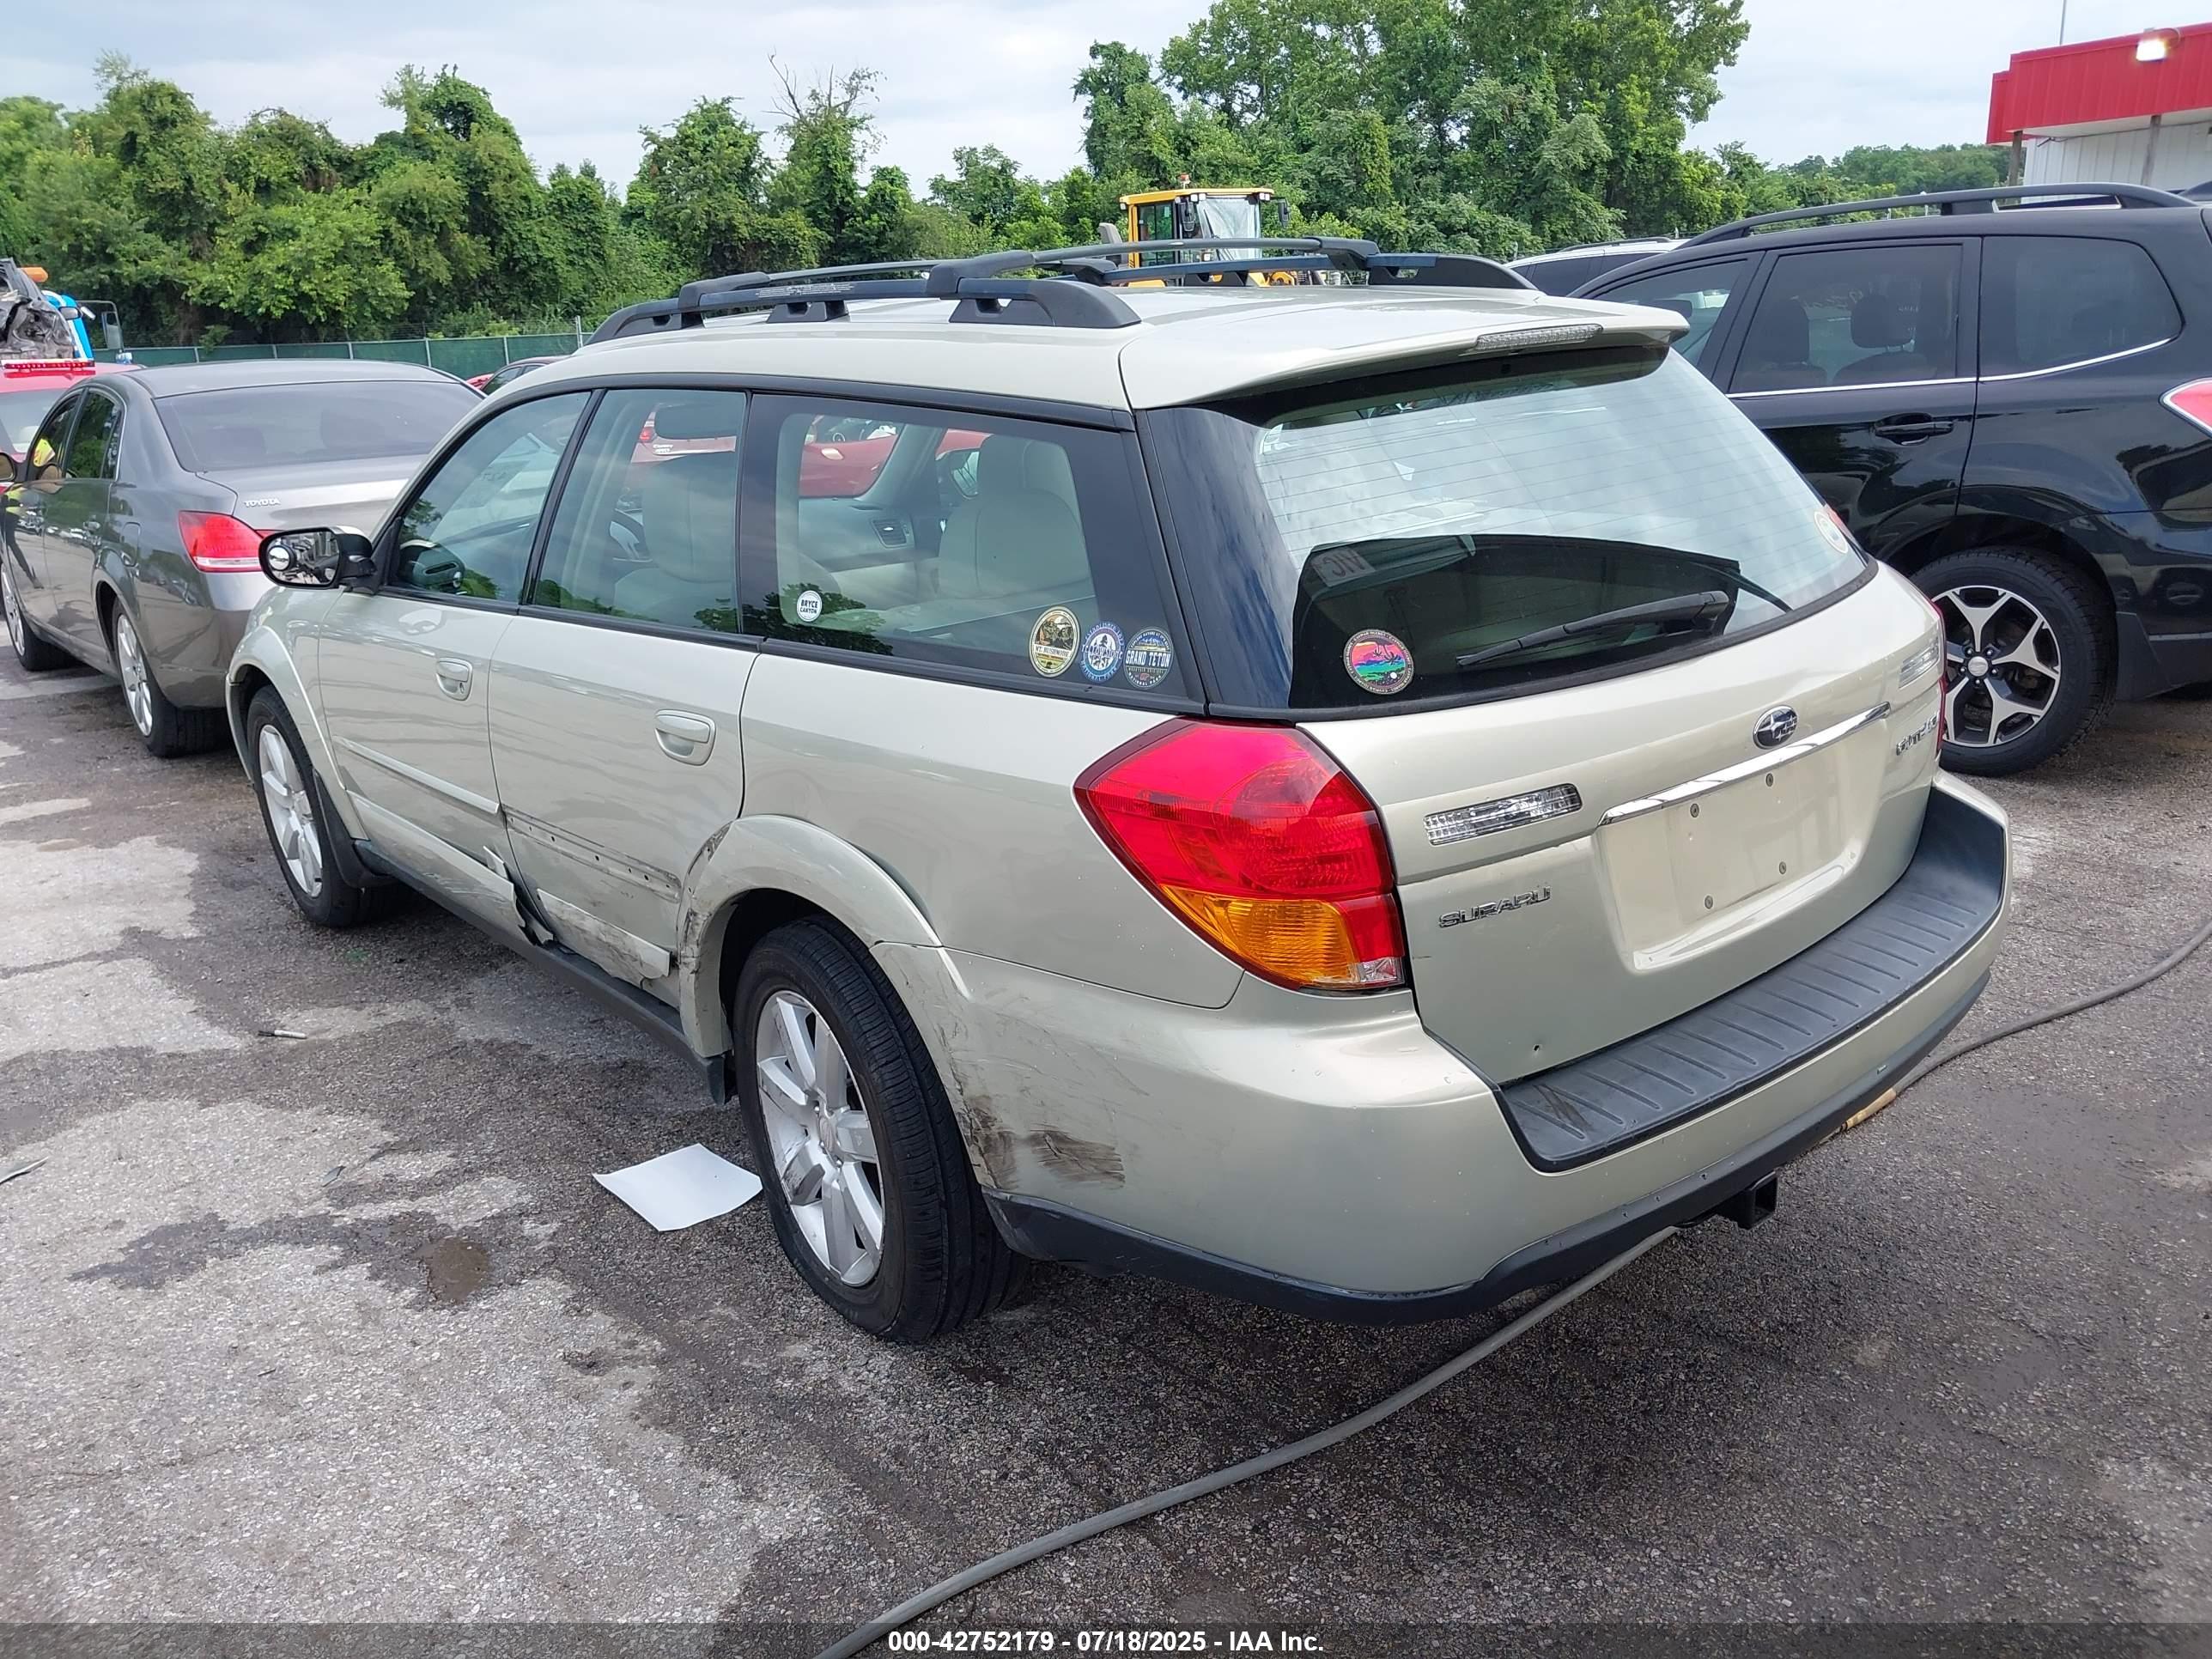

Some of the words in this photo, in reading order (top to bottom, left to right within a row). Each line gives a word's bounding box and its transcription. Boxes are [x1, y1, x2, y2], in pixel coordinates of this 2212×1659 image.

[244, 498, 281, 507] TOYOTA
[800, 599, 818, 609] BRYCE
[1125, 650, 1147, 665] GRAND
[1148, 652, 1171, 667] TETON
[1437, 885, 1552, 928] SUBARU
